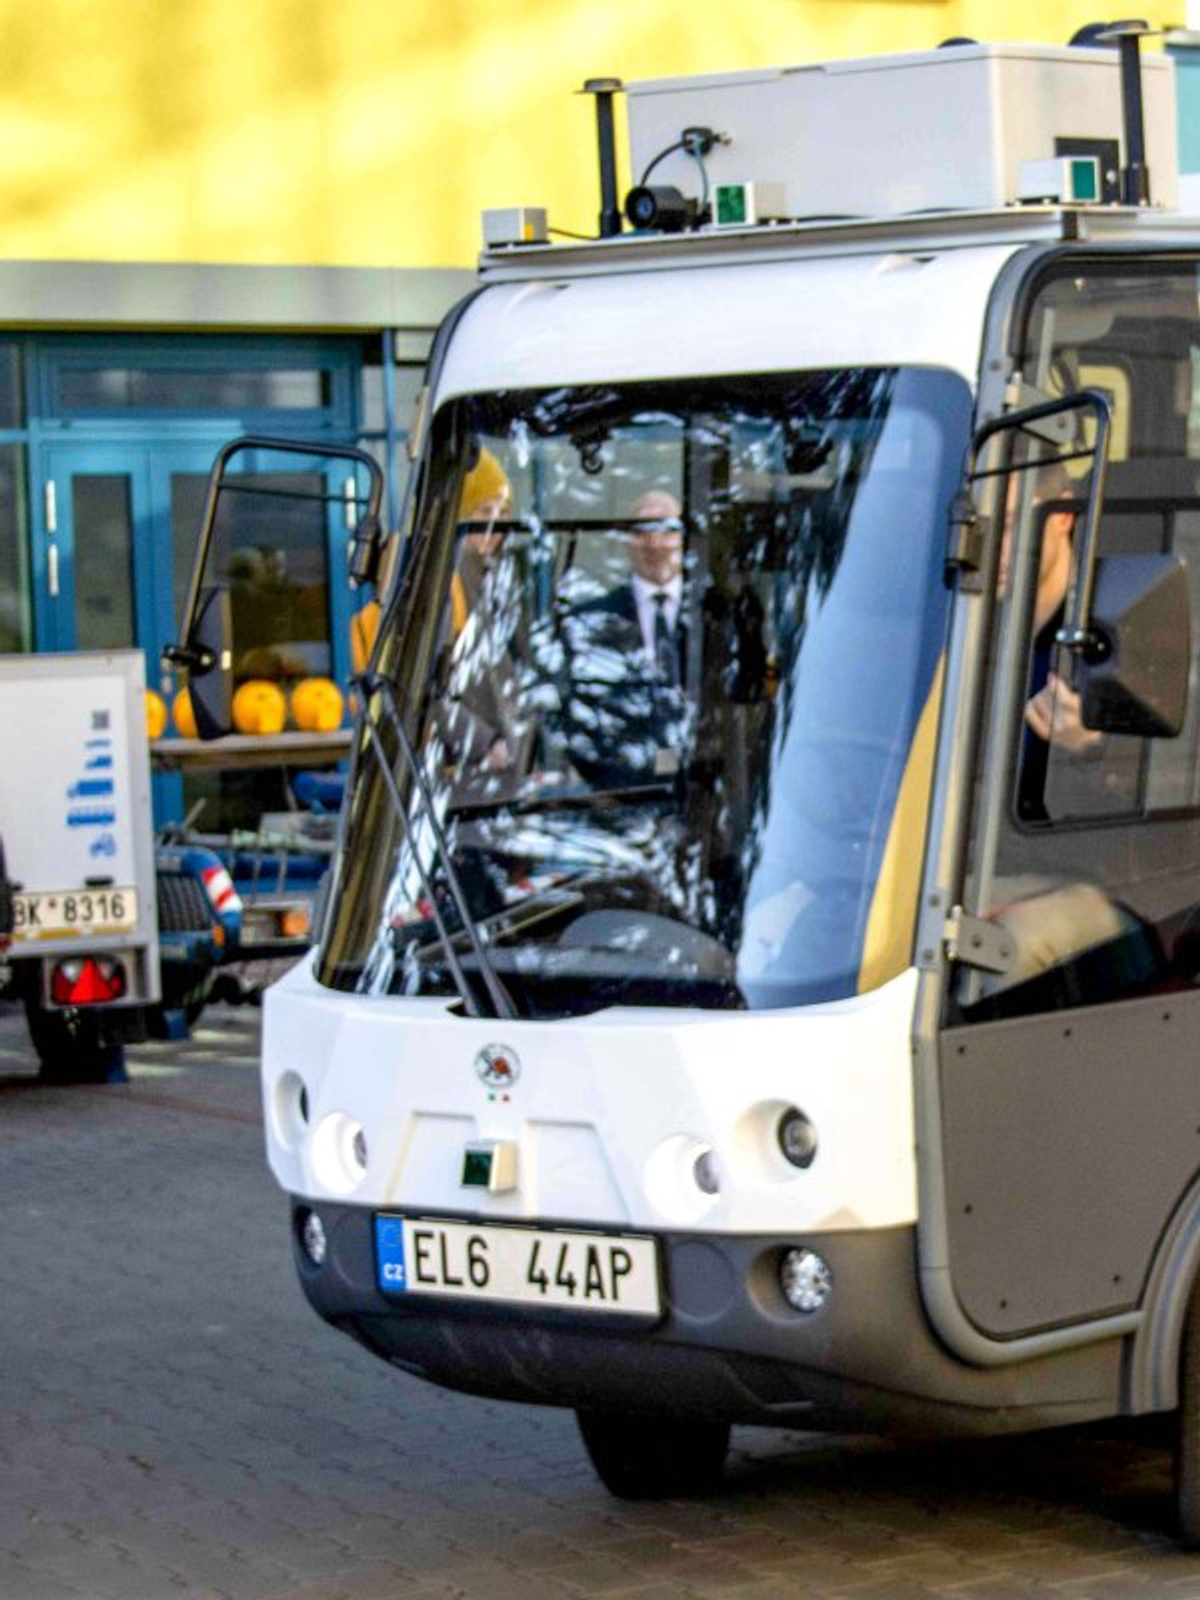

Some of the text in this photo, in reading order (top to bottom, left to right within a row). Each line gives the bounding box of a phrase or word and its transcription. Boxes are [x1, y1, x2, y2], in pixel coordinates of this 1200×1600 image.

[384, 1263, 404, 1281] CZ
[413, 1229, 633, 1301] EL6 44AP
